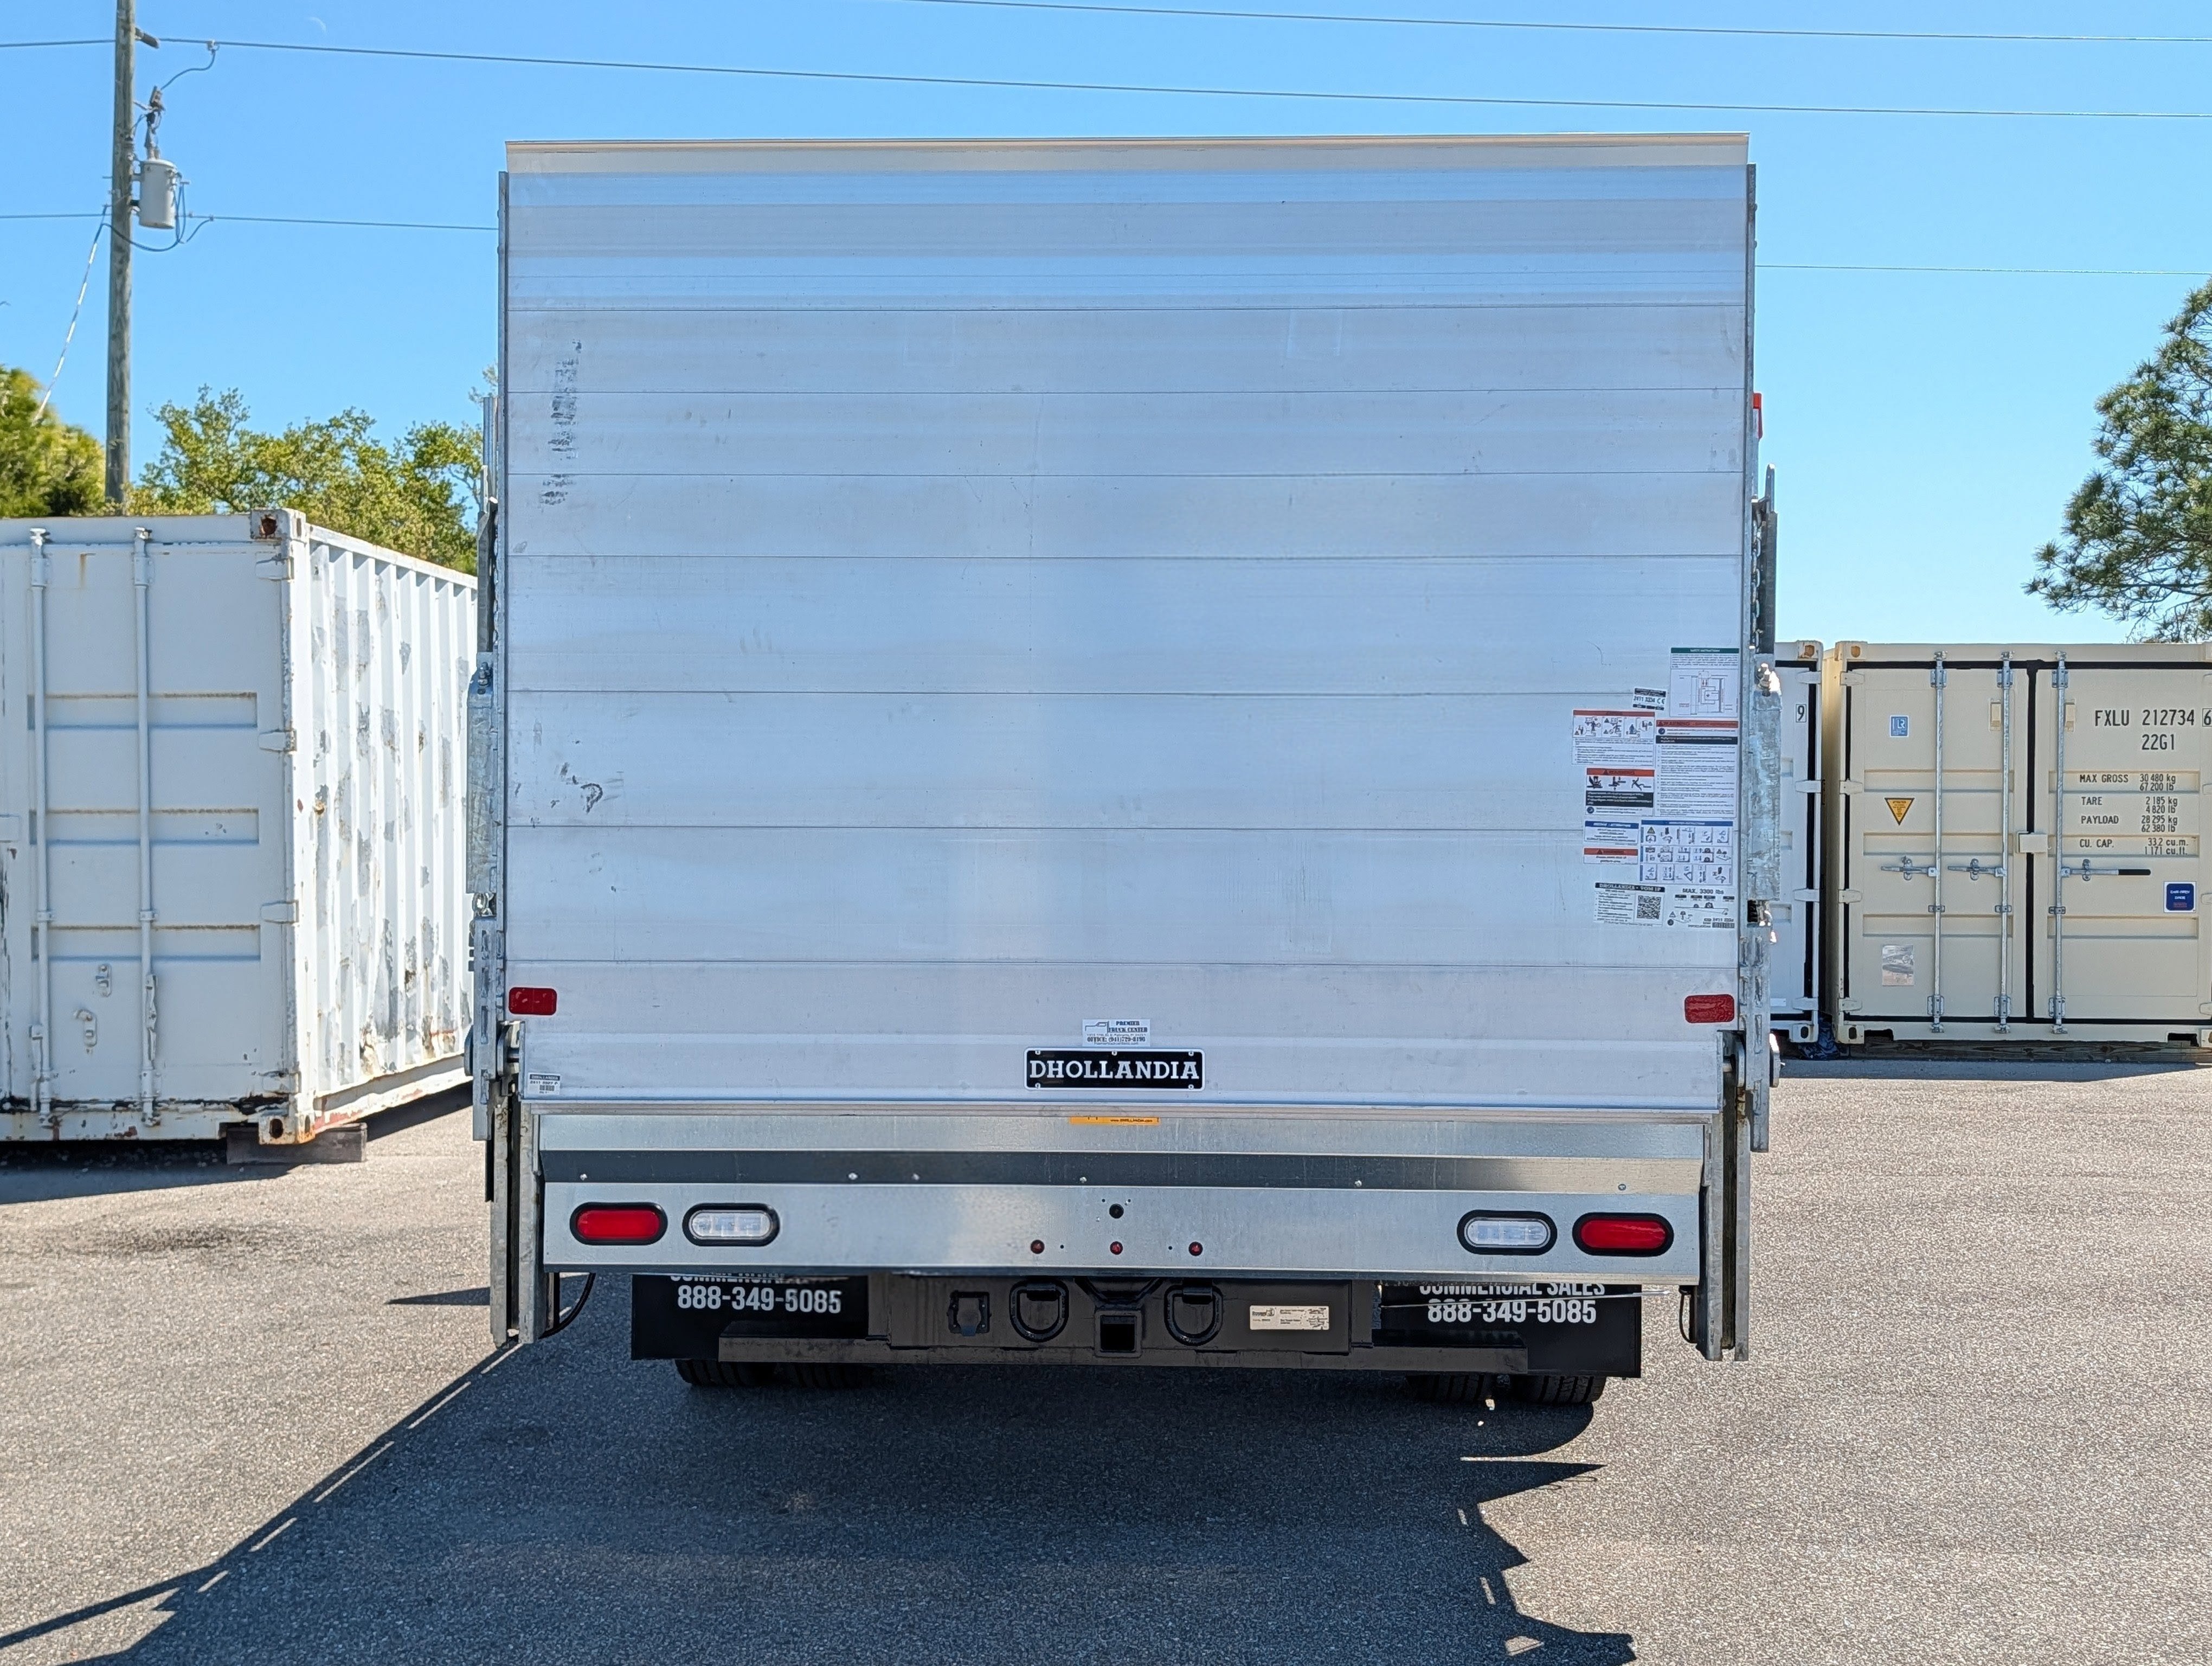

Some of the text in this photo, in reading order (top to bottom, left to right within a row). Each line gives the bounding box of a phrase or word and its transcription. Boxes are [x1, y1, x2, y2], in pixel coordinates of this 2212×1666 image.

[1797, 705, 1805, 721] 9
[2095, 709, 2211, 726] FXLU 212734 6
[2142, 734, 2174, 750] 22G1
[2080, 774, 2097, 783] MAX
[2101, 774, 2129, 783] GROSS
[2166, 773, 2176, 784] kg
[2166, 783, 2174, 791] lb
[2081, 797, 2102, 805] TARE
[2169, 796, 2178, 807] kg
[2168, 805, 2176, 813] lb
[2081, 816, 2119, 824] PAYLOAD
[2169, 815, 2178, 826] kg
[2168, 824, 2176, 832] lb
[2080, 839, 2092, 848] CU.
[2096, 839, 2114, 848] CAP.
[1030, 1060, 1199, 1079] DHOLLANDIA
[678, 1285, 842, 1313] 888-349-5085
[1427, 1298, 1597, 1323] 888-349-5085
